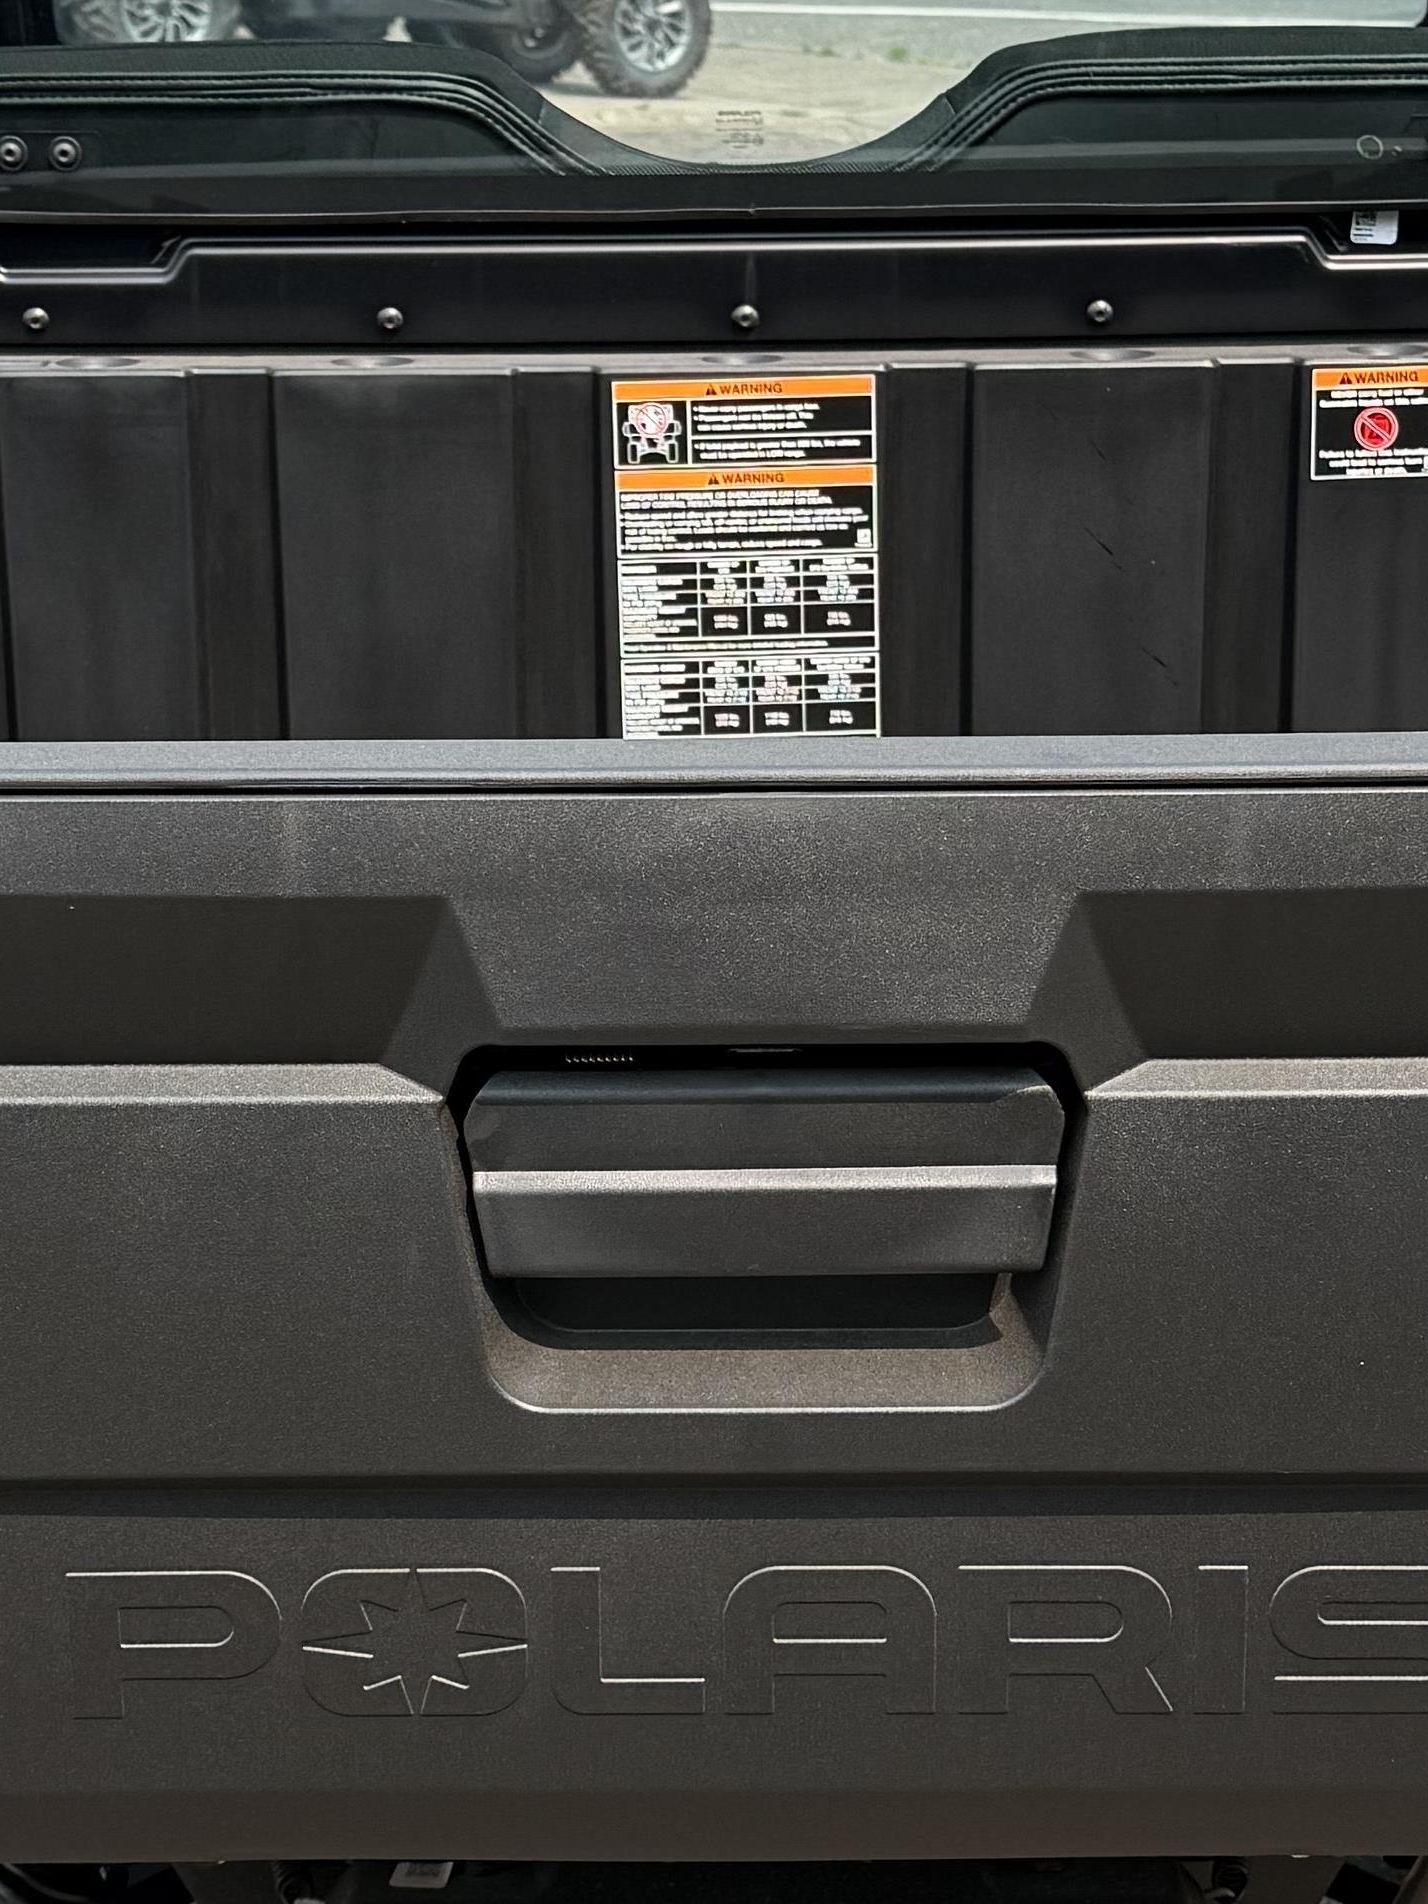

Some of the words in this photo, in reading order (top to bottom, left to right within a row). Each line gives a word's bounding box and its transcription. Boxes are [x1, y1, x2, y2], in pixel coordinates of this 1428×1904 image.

[1355, 371, 1419, 385] WARNING
[720, 382, 783, 395] WARNING
[722, 471, 785, 485] WARNING
